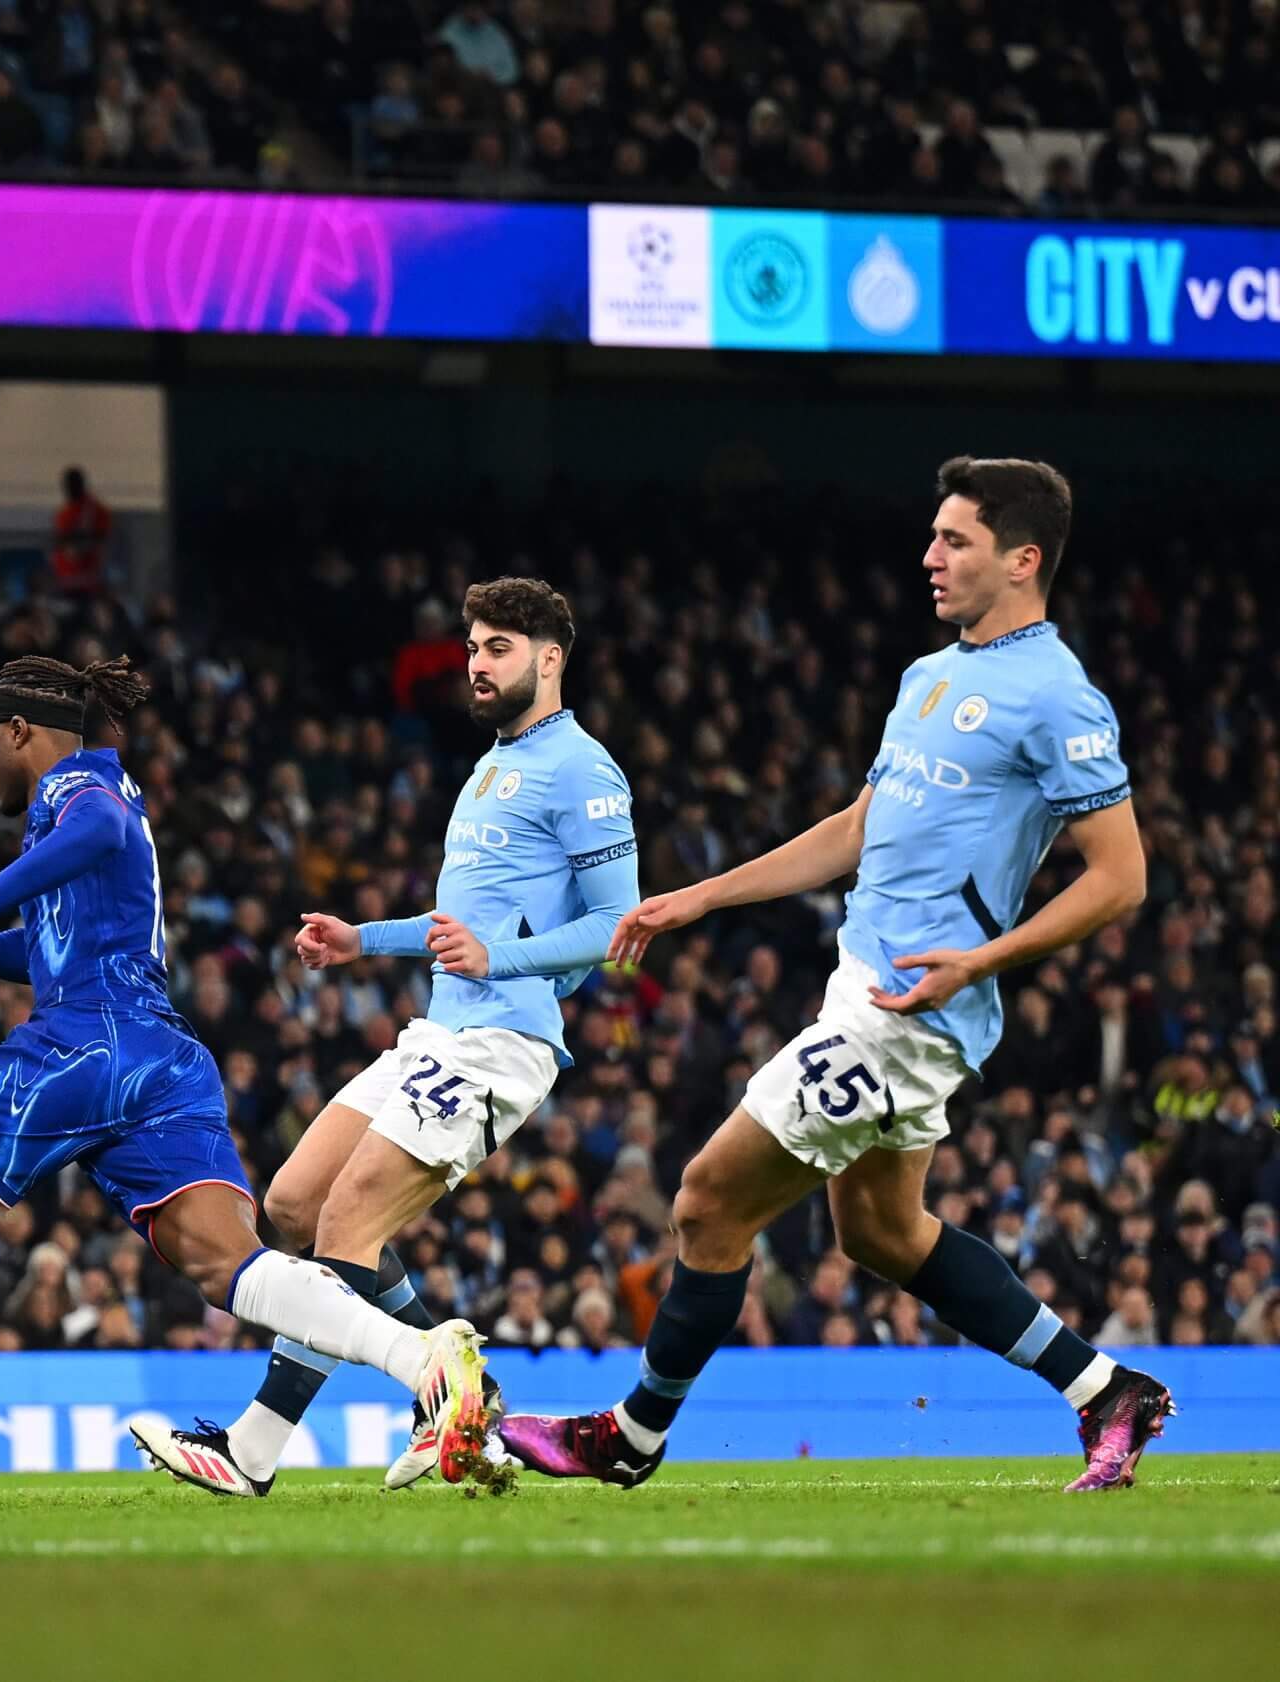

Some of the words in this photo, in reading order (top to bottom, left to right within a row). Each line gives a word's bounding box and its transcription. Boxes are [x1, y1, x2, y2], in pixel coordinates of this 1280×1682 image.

[1025, 233, 1186, 346] CITY
[1185, 277, 1222, 320] v
[400, 1054, 466, 1120] 24
[797, 1034, 881, 1117] 45
